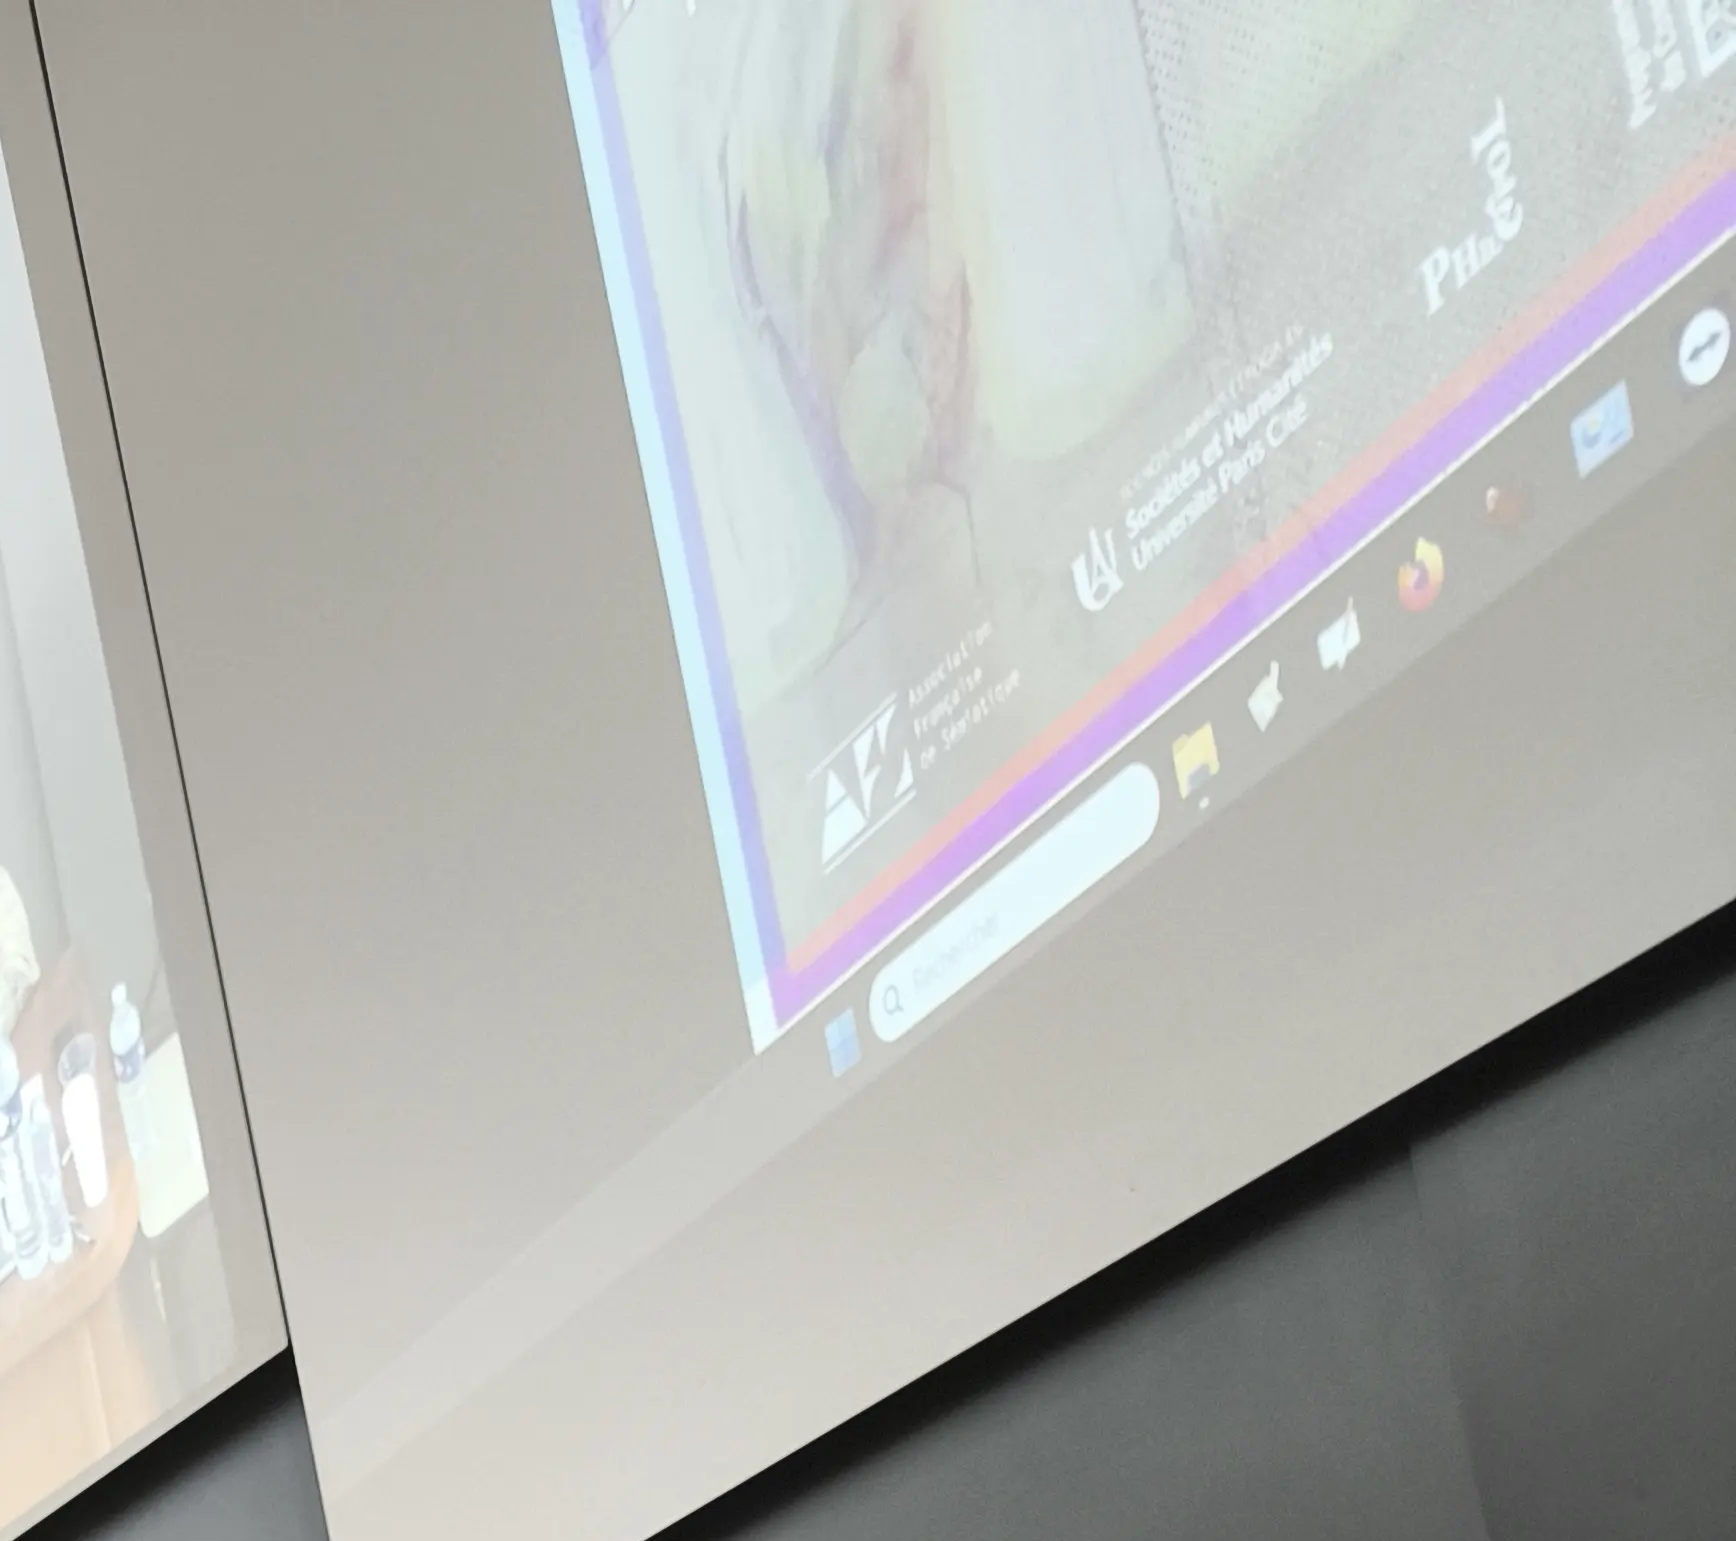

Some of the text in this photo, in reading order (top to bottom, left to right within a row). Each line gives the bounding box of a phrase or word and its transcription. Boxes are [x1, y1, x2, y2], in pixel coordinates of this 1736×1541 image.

[1125, 455, 1201, 540] Sociétés
[1202, 430, 1224, 468] et
[1224, 332, 1333, 447] Humanités
[1131, 477, 1218, 572] Université
[1218, 440, 1265, 494] Paris
[909, 620, 992, 708] Association
[914, 667, 982, 739] Française
